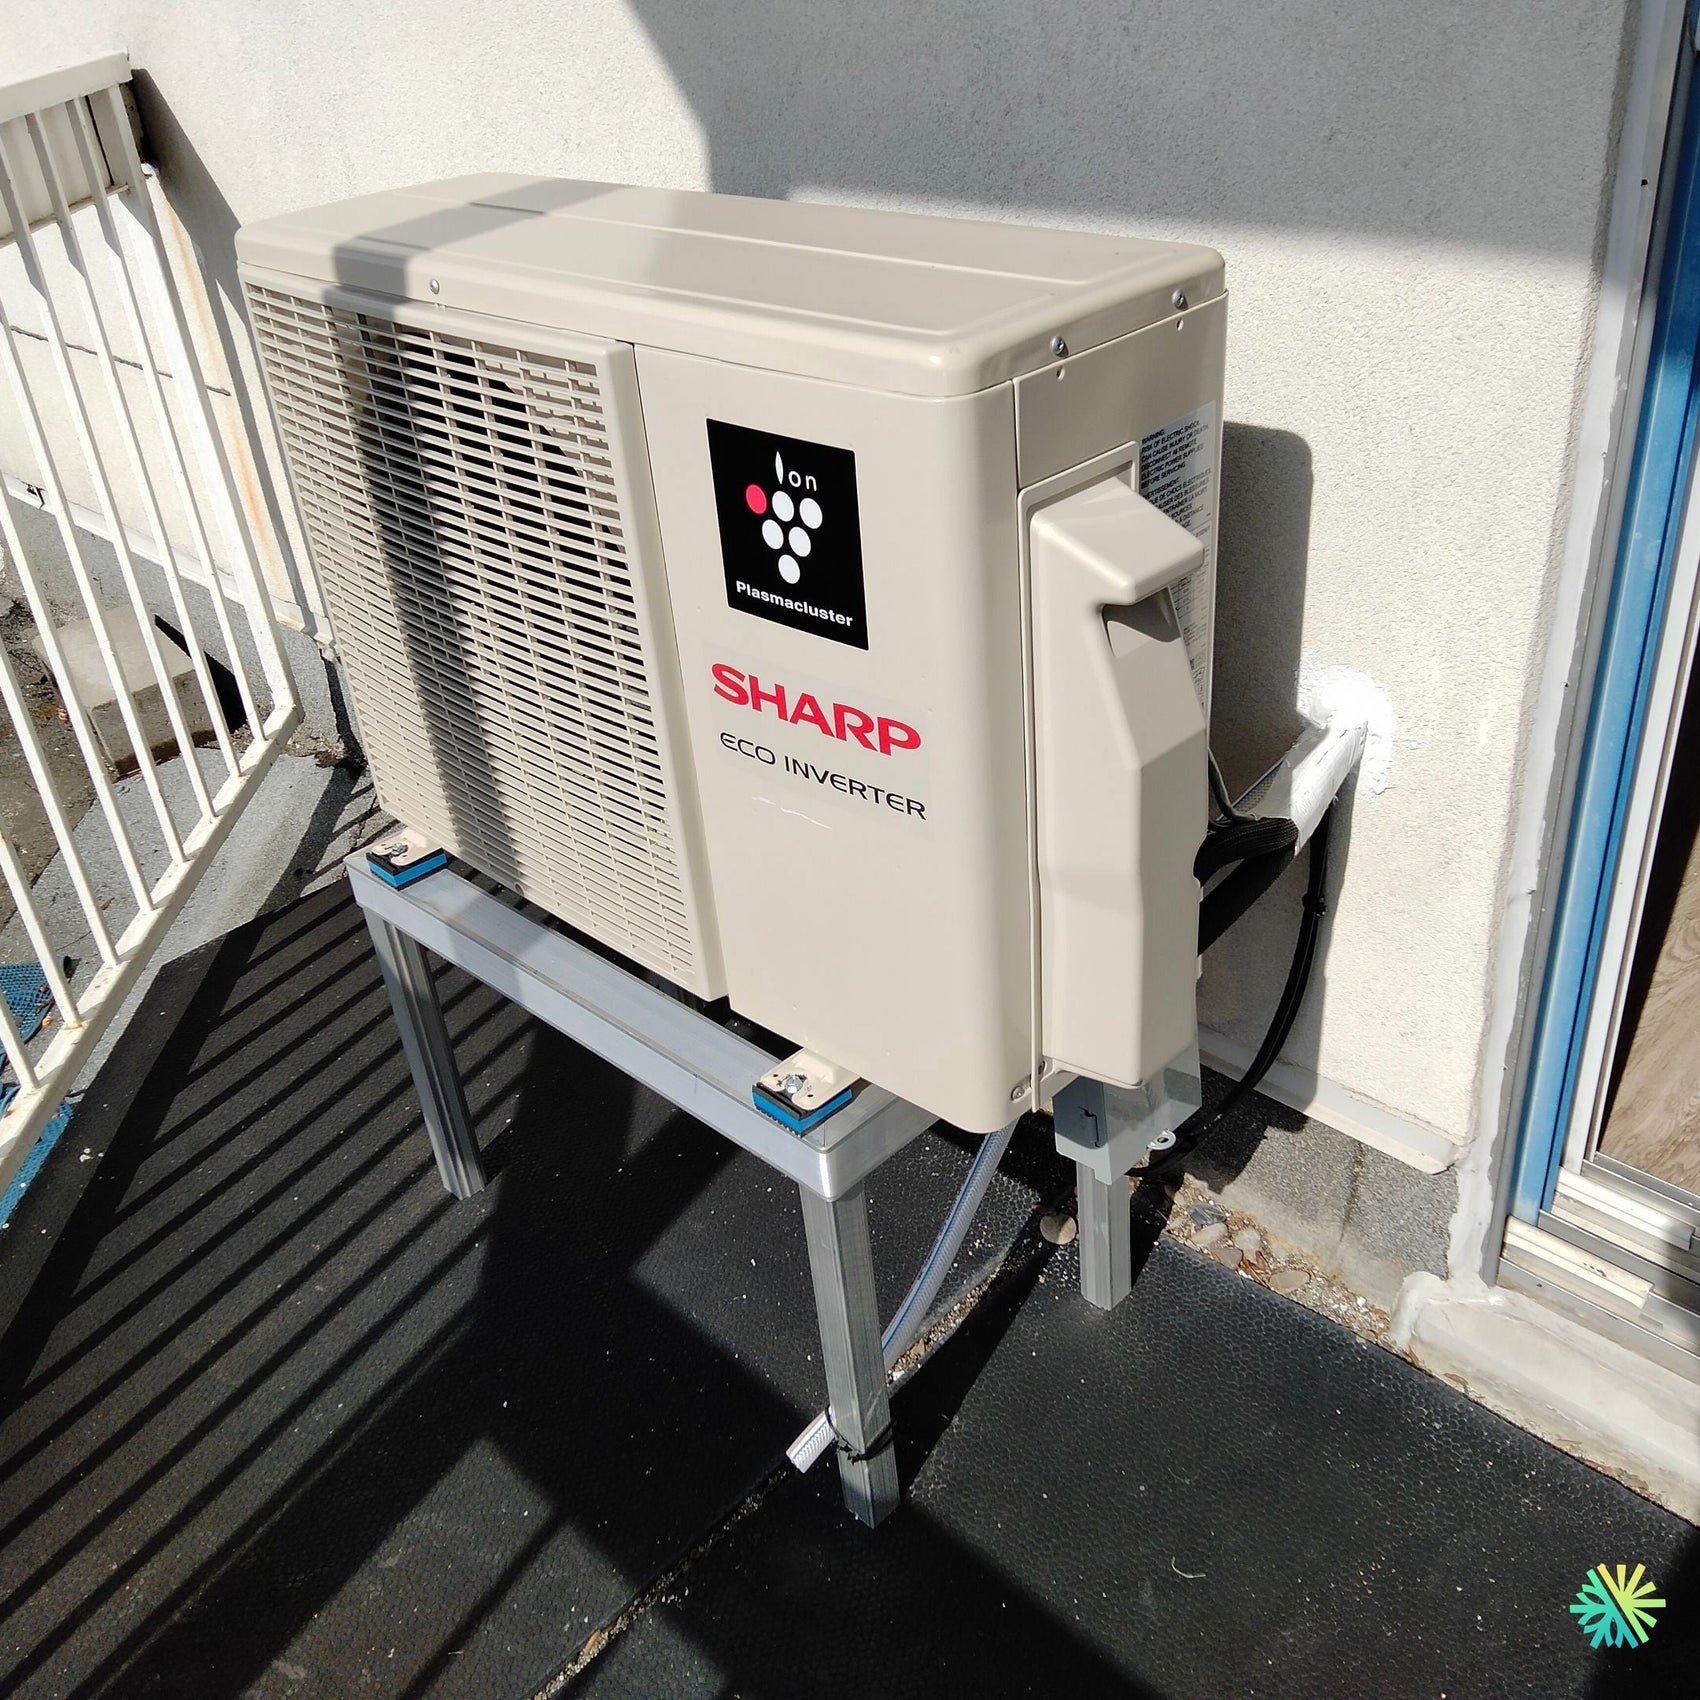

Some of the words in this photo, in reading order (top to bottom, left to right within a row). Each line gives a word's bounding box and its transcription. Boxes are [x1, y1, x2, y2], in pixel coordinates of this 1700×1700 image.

[1141, 443, 1152, 454] RISK
[1161, 428, 1183, 444] ELECTRIC
[1141, 452, 1150, 463] CAN
[1153, 444, 1167, 457] CAUSE
[1169, 436, 1185, 448] INJURY
[1141, 451, 1170, 471] DISCONNECT
[1179, 438, 1196, 452] REMOTE
[776, 451, 816, 491] Ion
[1141, 464, 1163, 480] ELECTRIC
[1164, 455, 1181, 468] POWER
[1141, 474, 1159, 489] BEFORE
[1174, 492, 1182, 501] DES
[736, 581, 853, 626] Plasmacluster
[711, 663, 921, 755] SHARP
[721, 733, 775, 764] ECO
[785, 756, 926, 820] INVERTER
